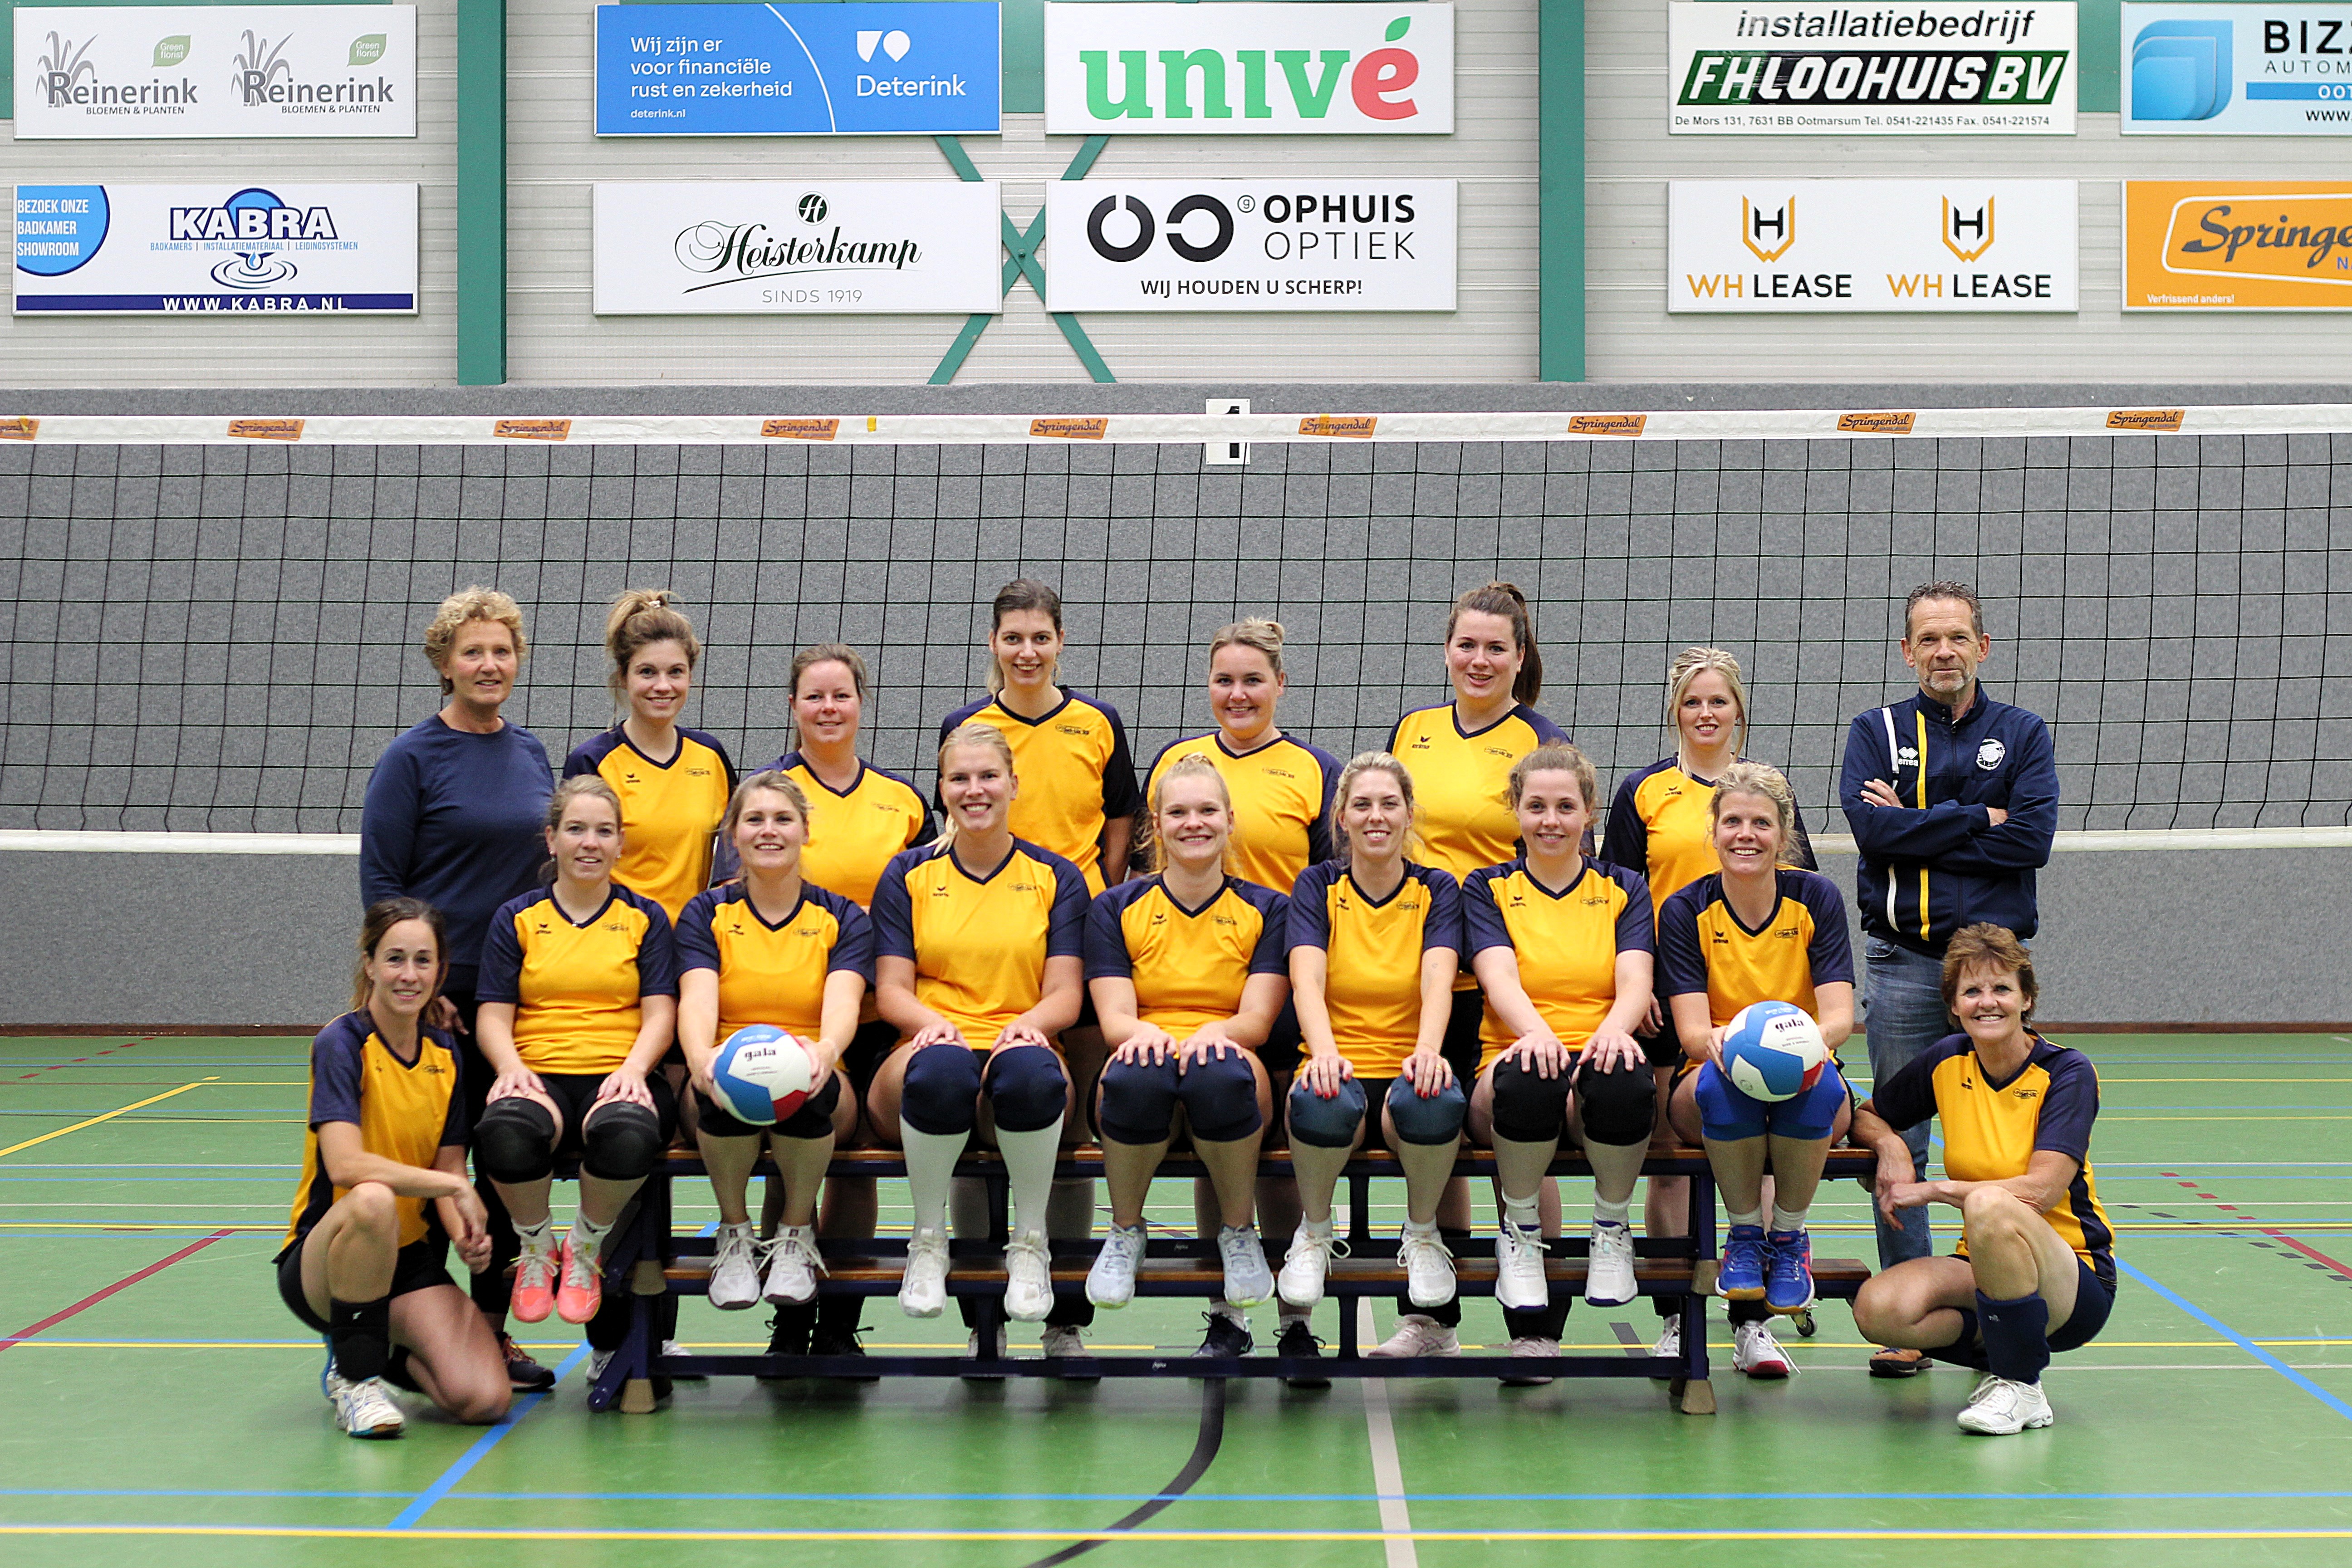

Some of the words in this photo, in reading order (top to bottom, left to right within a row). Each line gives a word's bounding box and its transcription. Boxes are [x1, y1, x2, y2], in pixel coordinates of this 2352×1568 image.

[1737, 10, 2035, 44] installatiebedrijf
[2264, 20, 2352, 54] BIZ
[161, 42, 184, 52] Green
[356, 41, 380, 51] Green
[630, 36, 662, 56] Wij
[666, 35, 699, 56] zijn
[702, 39, 722, 53] er
[161, 50, 183, 59] florist
[356, 49, 379, 58] florist
[631, 62, 674, 76] voor
[677, 58, 771, 75] financiële
[1080, 16, 1419, 120] univé
[48, 70, 198, 105] Reinerink
[243, 69, 394, 104] Reinerink
[631, 82, 668, 98] rust
[672, 84, 696, 98] en
[700, 80, 793, 98] zekerheid
[856, 73, 966, 98] Deterink
[630, 108, 685, 119] deterink.nl
[1676, 116, 1689, 125] De
[1693, 117, 1720, 125] Mors
[1725, 117, 1745, 126] 131,
[1749, 116, 1773, 125] 7631
[1778, 117, 1793, 125] BB
[1797, 116, 1861, 125] Ootmarsum
[1865, 116, 1882, 125] Tel.
[1886, 117, 1953, 125] 0541-221435
[1957, 116, 1979, 125] Fax.
[1983, 116, 2049, 125] 0541-221574
[17, 200, 59, 214] BEZOEK
[61, 199, 89, 213] ONZE
[1264, 195, 1414, 223] OPHUIS
[17, 221, 77, 235] BADKAMER
[170, 206, 338, 240] KABRA
[2181, 206, 2352, 268] Springe
[17, 243, 79, 256] SHOWROOM
[150, 242, 192, 251] BADKAMERS
[203, 242, 284, 250] INSTALLATIEMATERIAAL
[674, 220, 923, 276] Heisterkamp
[1265, 232, 1415, 260] OPTIEK
[2337, 257, 2352, 270] N
[1141, 281, 1170, 298] WIJ
[1178, 280, 1259, 294] HOUDEN
[1267, 280, 1278, 294] U
[1286, 280, 1361, 294] SCHERP!
[1687, 274, 1742, 298] WH
[1754, 274, 1852, 297] LEASE
[1886, 274, 1942, 297] WH
[1954, 274, 2051, 297] LEASE
[763, 290, 819, 303] SINDS
[828, 290, 862, 302] 1919
[2147, 294, 2199, 304] Verfrissend
[2201, 294, 2234, 304] anders!
[162, 298, 348, 311] WWW.KABRA.NL
[1572, 417, 1640, 432] Springendal
[1841, 414, 1908, 430] Springendal
[2111, 412, 2177, 427] Springendal
[231, 421, 297, 436] Springendal
[498, 421, 564, 436] Springendal
[764, 421, 831, 436] Springendal
[1034, 420, 1100, 435] Springendal
[1775, 1018, 1804, 1033] gala
[744, 1048, 776, 1062] gala
